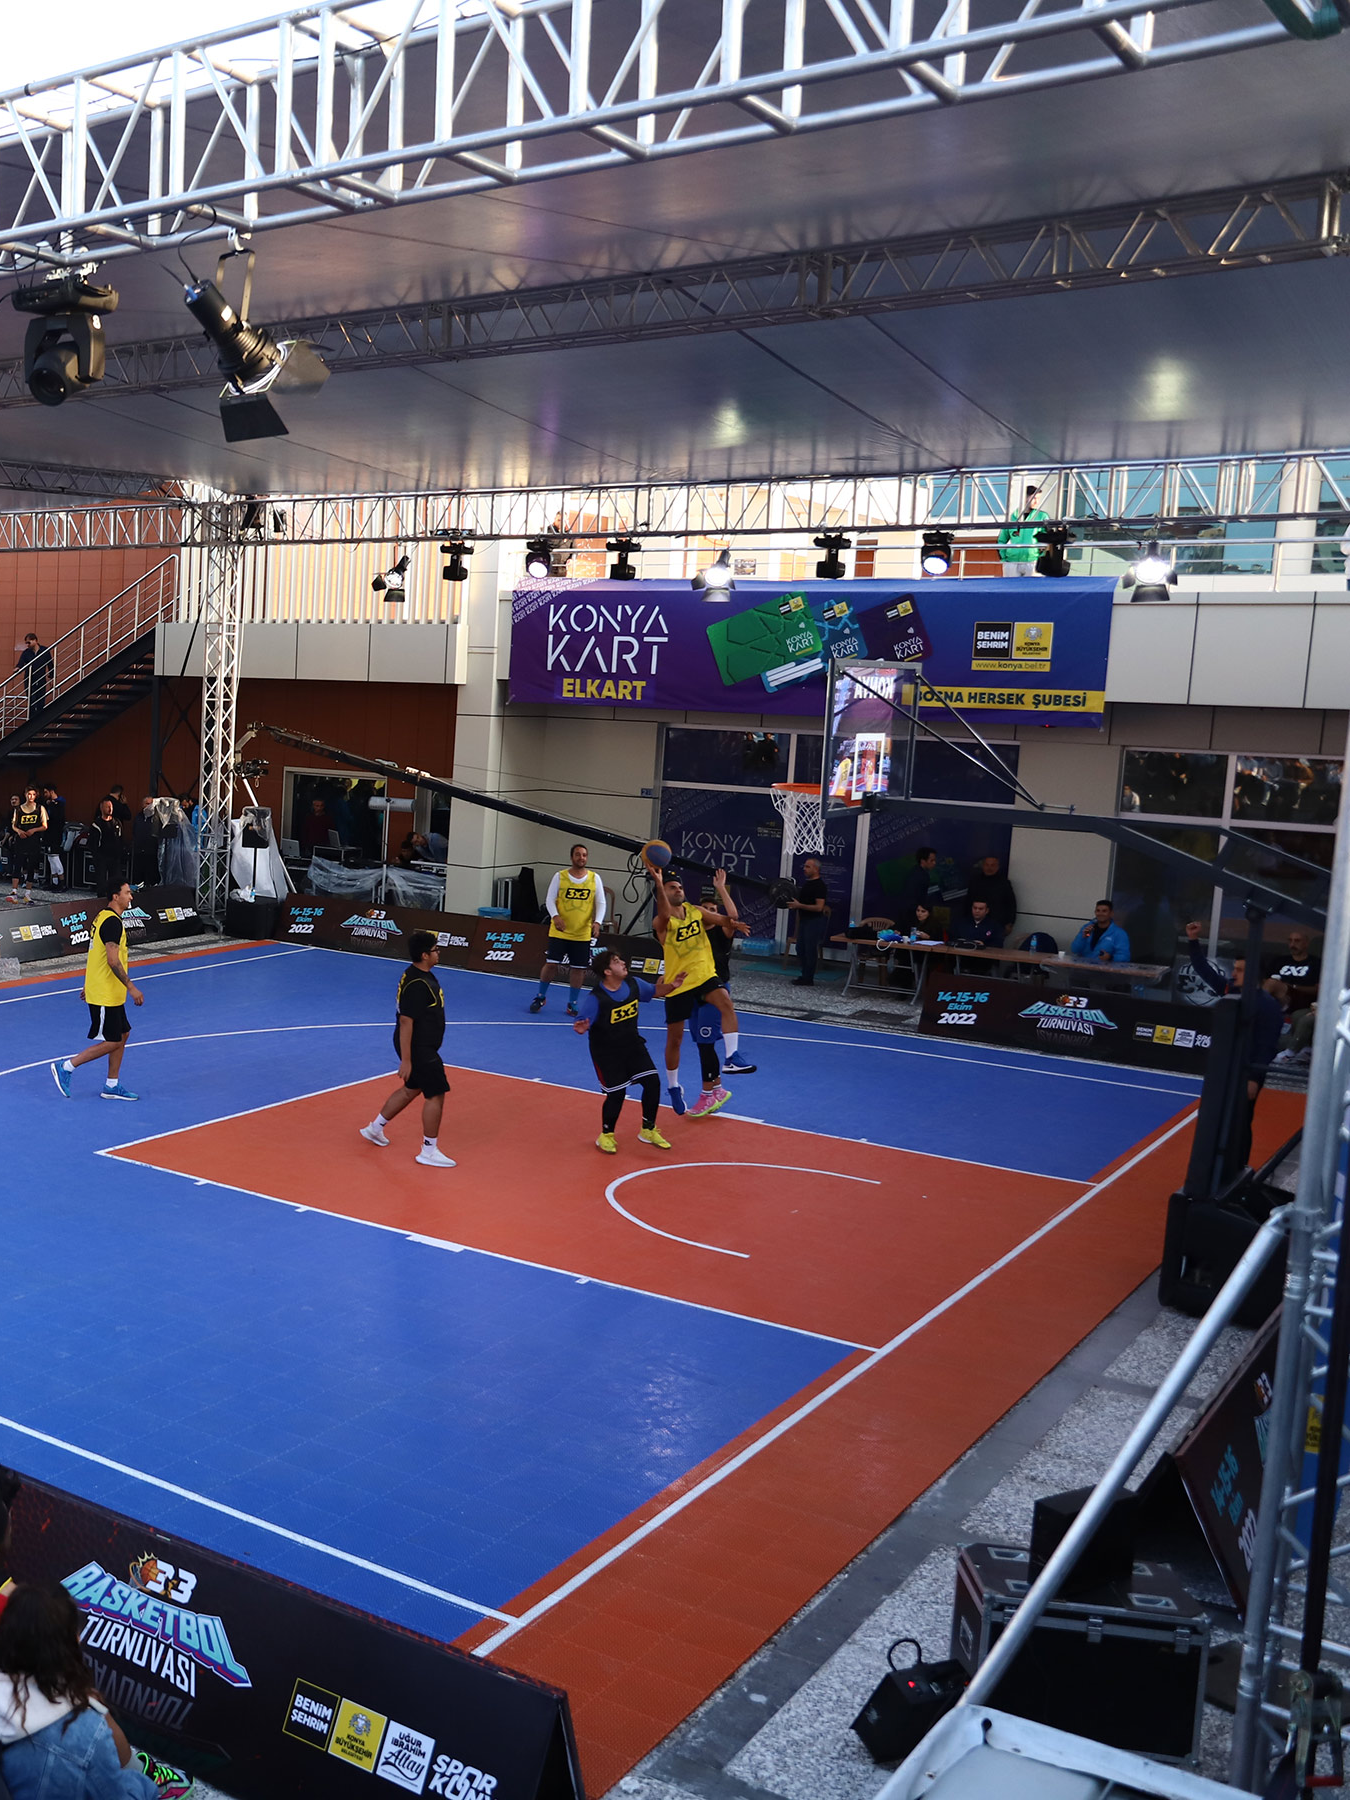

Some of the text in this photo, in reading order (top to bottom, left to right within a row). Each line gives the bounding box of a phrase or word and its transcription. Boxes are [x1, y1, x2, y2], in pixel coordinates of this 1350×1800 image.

[549, 604, 669, 634] KONYA
[786, 630, 814, 646] KONYA
[788, 637, 814, 653] KART
[830, 636, 859, 652] KONYA
[893, 636, 923, 651] KONYA
[547, 634, 669, 675] KART
[832, 643, 859, 659] KART
[895, 643, 924, 660] KART
[975, 661, 1047, 671] www.konya.bel.tr
[562, 678, 647, 700] ELKART
[967, 692, 1025, 706] HERSEK
[681, 830, 756, 853] KONYA
[567, 889, 590, 899] 3x3
[60, 911, 88, 927] 14-15-16
[289, 906, 325, 917] 14-15-16
[288, 924, 315, 934] 2022
[342, 914, 402, 935] BASKETBOL
[678, 921, 701, 941] 3x3
[70, 931, 90, 945] 2022
[350, 926, 388, 941] TURNUVASI
[485, 932, 525, 943] 14-15-16
[492, 941, 512, 949] Ekim
[484, 950, 515, 962] 2022
[937, 991, 990, 1003] 14-15-16
[612, 1001, 638, 1023] 3x3
[947, 1002, 973, 1011] Ekim
[937, 1013, 978, 1025] 2022
[1020, 1001, 1116, 1029] BASKETBOL
[1036, 1017, 1095, 1036] TURNUVASI
[60, 1561, 252, 1687] BASKETBOL
[79, 1615, 196, 1698] TURNUVASI
[346, 1733, 365, 1747] KONYA
[399, 1731, 423, 1748] UĞUR
[384, 1748, 426, 1779] Altay
[432, 1754, 499, 1795] SPOR
